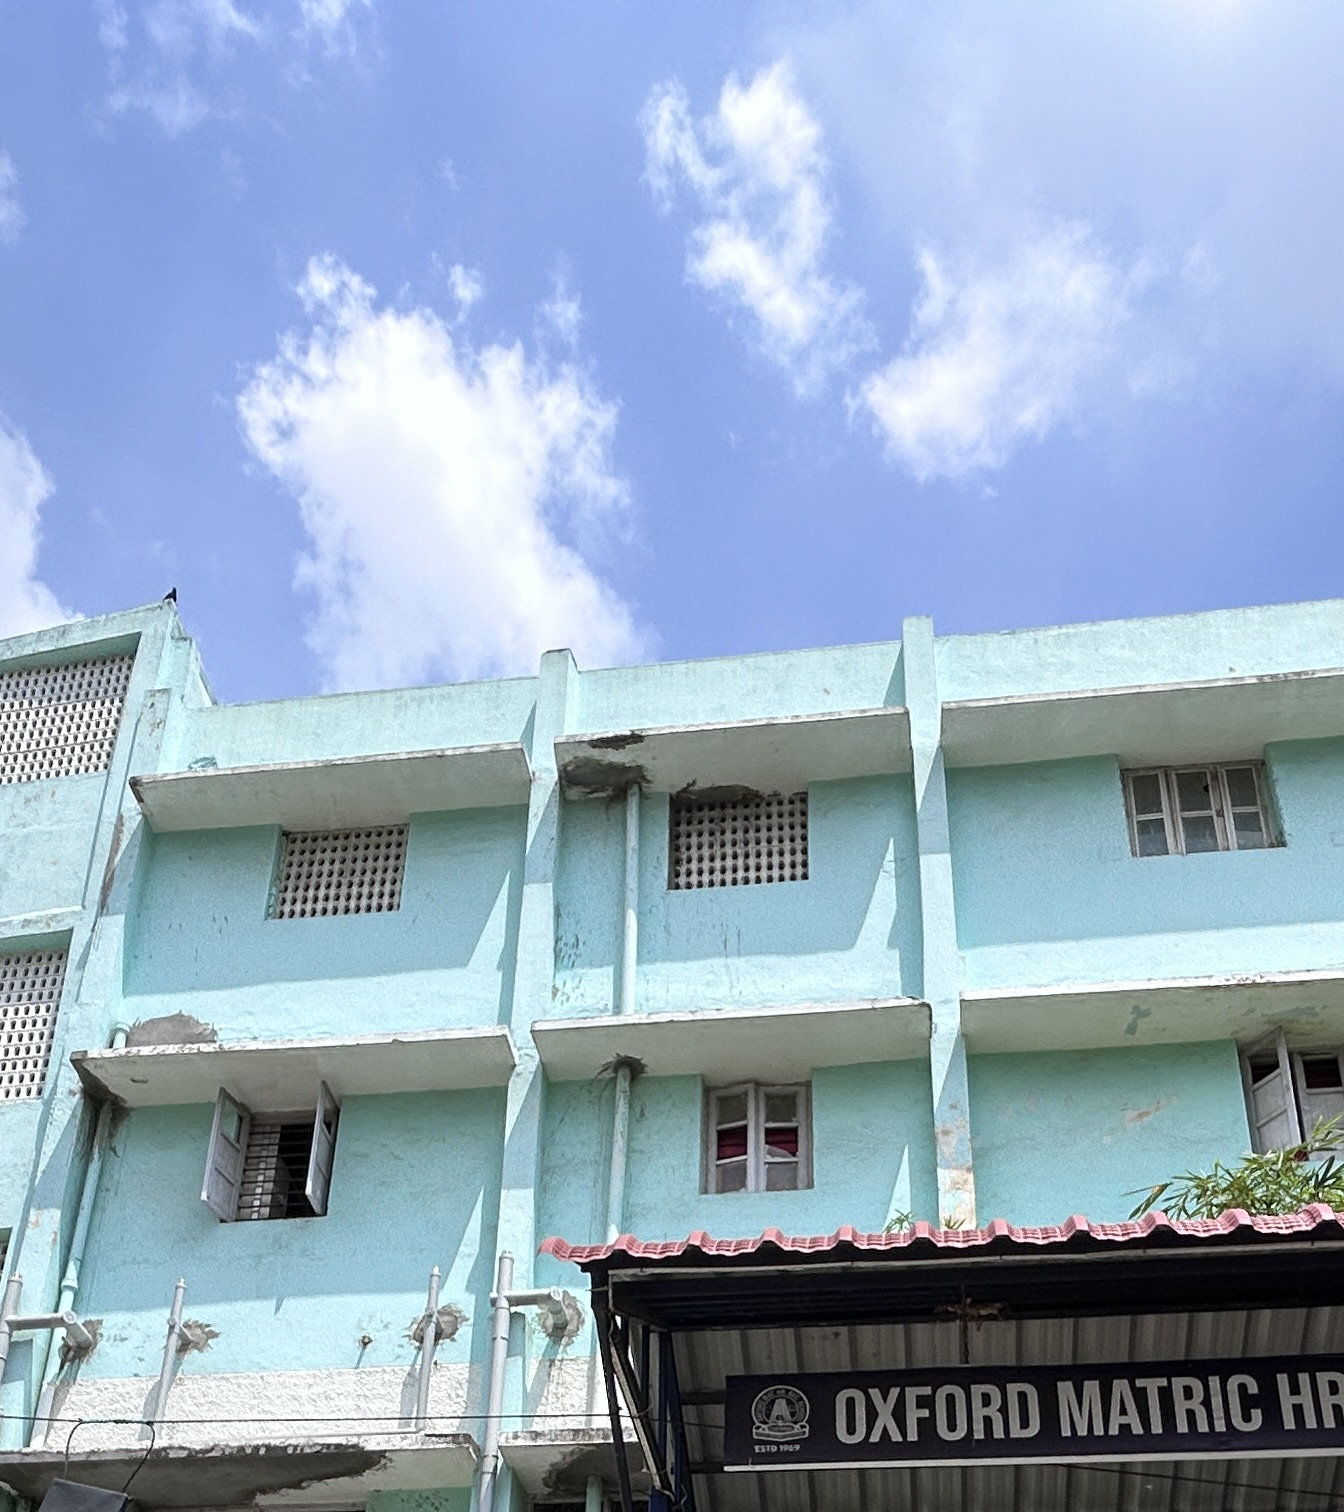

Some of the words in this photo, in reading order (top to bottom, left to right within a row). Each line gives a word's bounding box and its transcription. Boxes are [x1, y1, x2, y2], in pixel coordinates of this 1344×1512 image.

[836, 1384, 1040, 1444] OXFORD
[1058, 1375, 1263, 1437] MATRIC
[754, 1444, 778, 1453] ESTD
[779, 1443, 801, 1452] 1969
